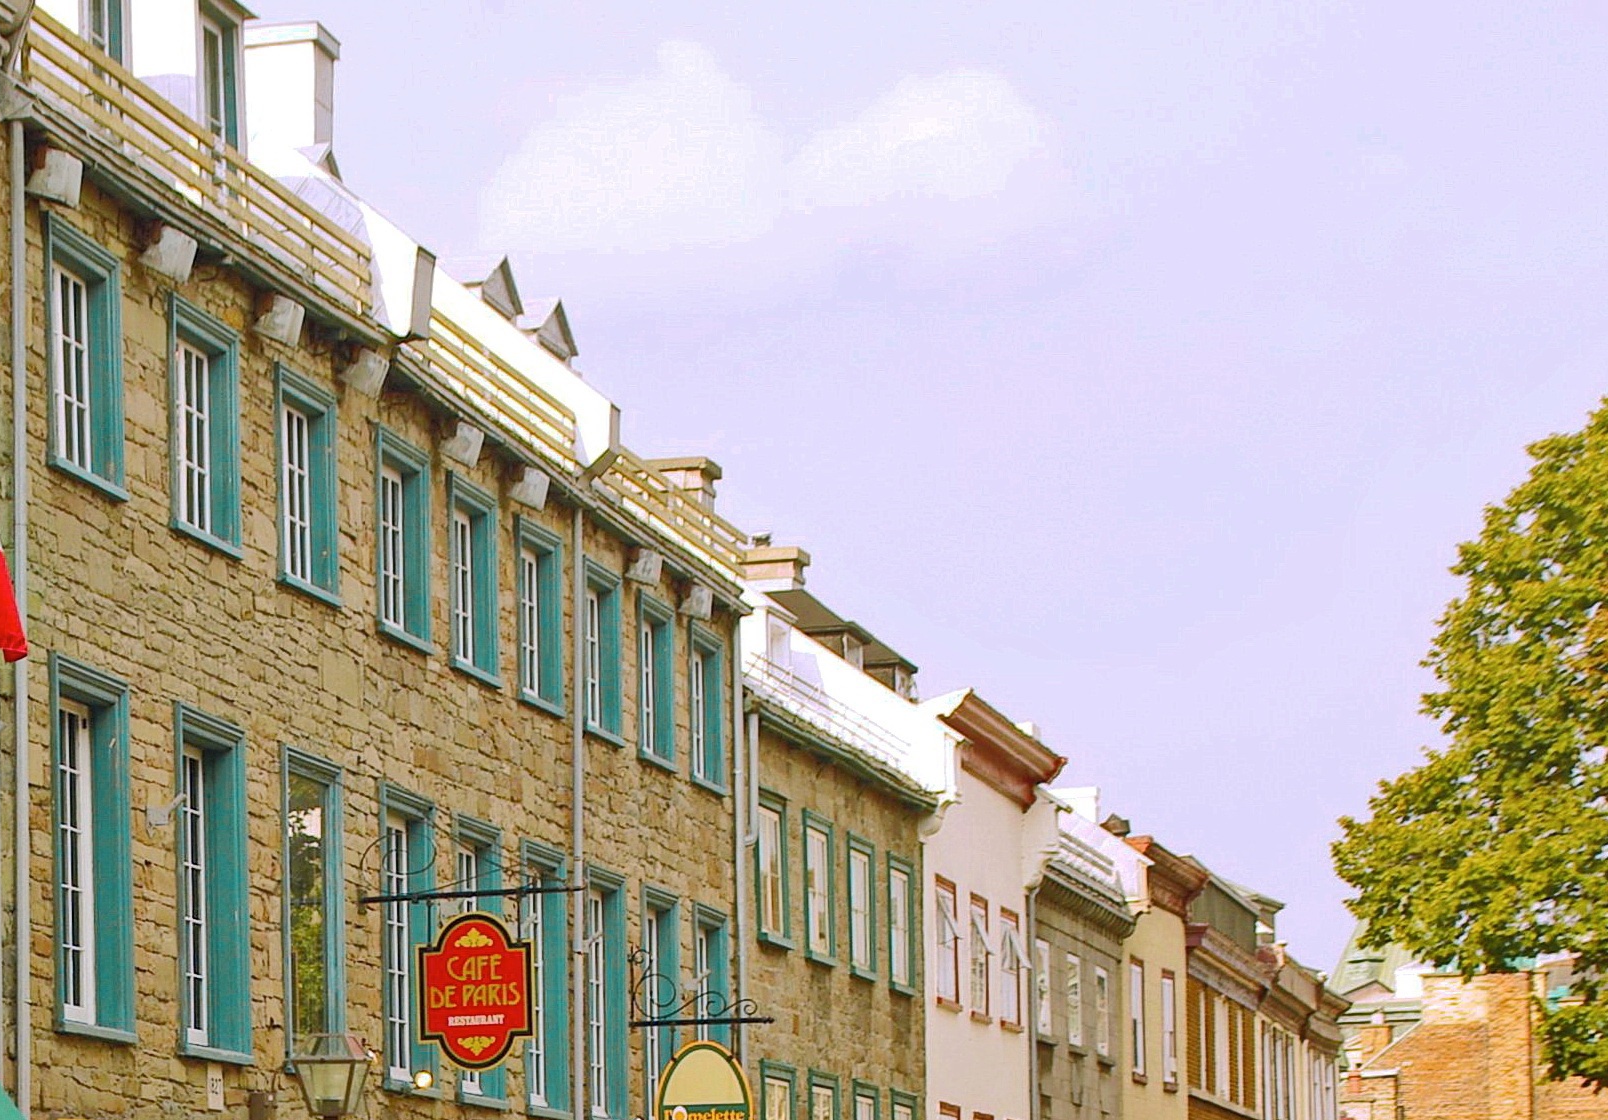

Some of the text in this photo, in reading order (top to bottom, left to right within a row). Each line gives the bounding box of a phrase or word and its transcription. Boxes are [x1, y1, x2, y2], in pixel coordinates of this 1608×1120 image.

[430, 982, 522, 1009] DE PARIS
[447, 1013, 505, 1027] RESTAURANT
